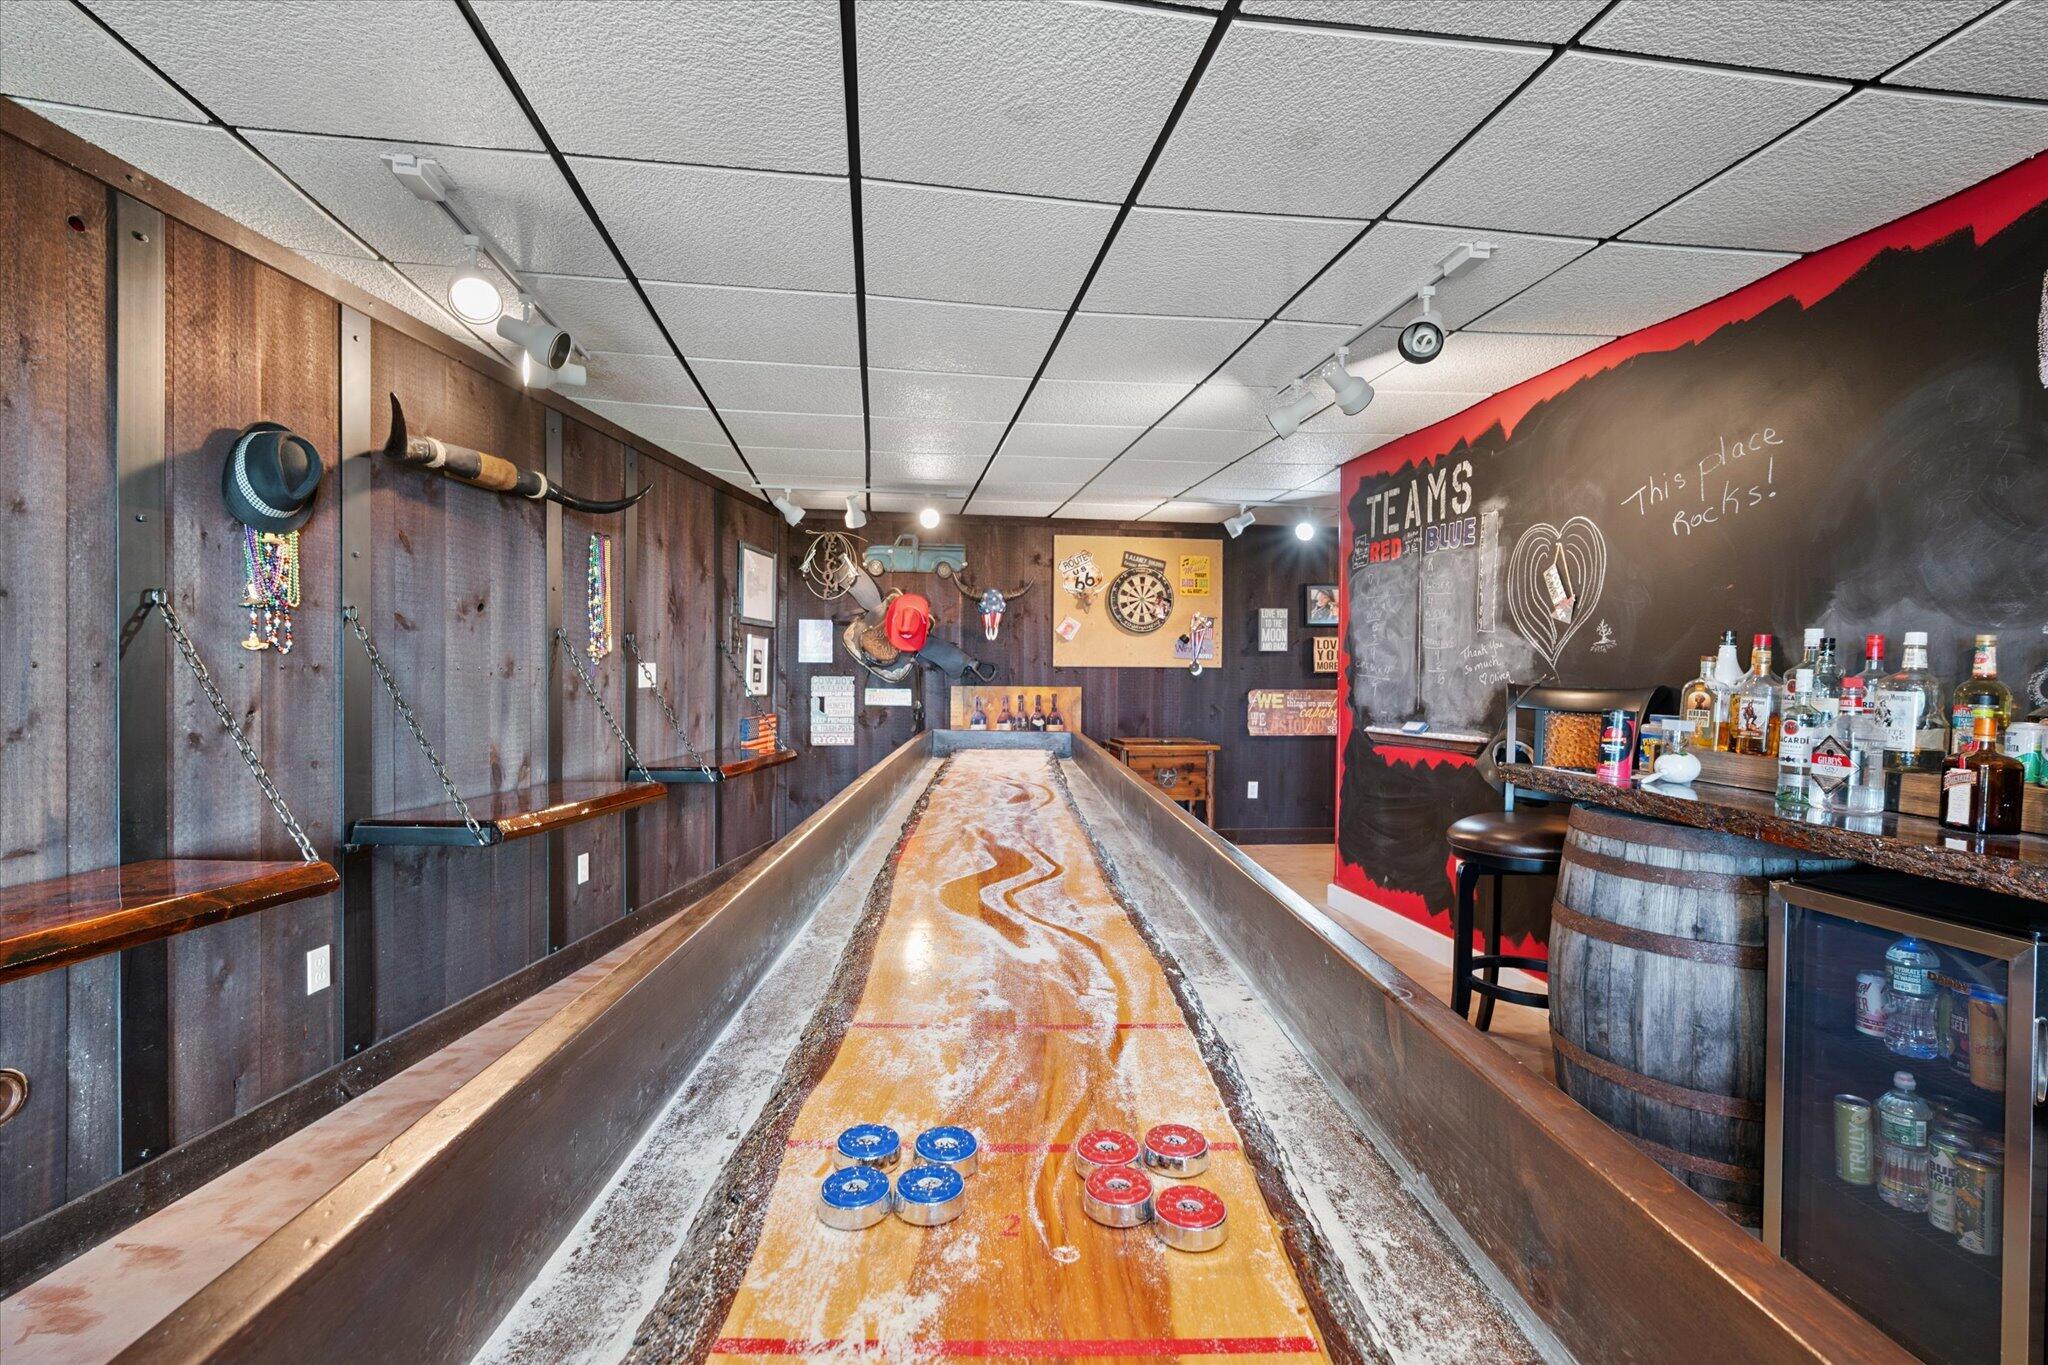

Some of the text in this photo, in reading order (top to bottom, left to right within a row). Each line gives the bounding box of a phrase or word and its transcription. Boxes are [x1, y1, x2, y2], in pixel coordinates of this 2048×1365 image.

[1366, 460, 1473, 538] TEAMS
[1620, 473, 1686, 515] This
[1425, 517, 1476, 554] BLUE
[1369, 537, 1402, 564] RED
[1063, 553, 1089, 570] ROUTE
[1074, 572, 1096, 591] 66
[1261, 628, 1288, 642] MOON
[1317, 640, 1337, 650] LOV
[1317, 650, 1338, 661] YO
[812, 677, 855, 685] COWBOY
[1257, 693, 1285, 709] WE
[1286, 700, 1307, 709] things
[813, 736, 854, 744] RIGHT
[1848, 1121, 1867, 1175] TRULY
[1002, 1214, 1021, 1237] 2
